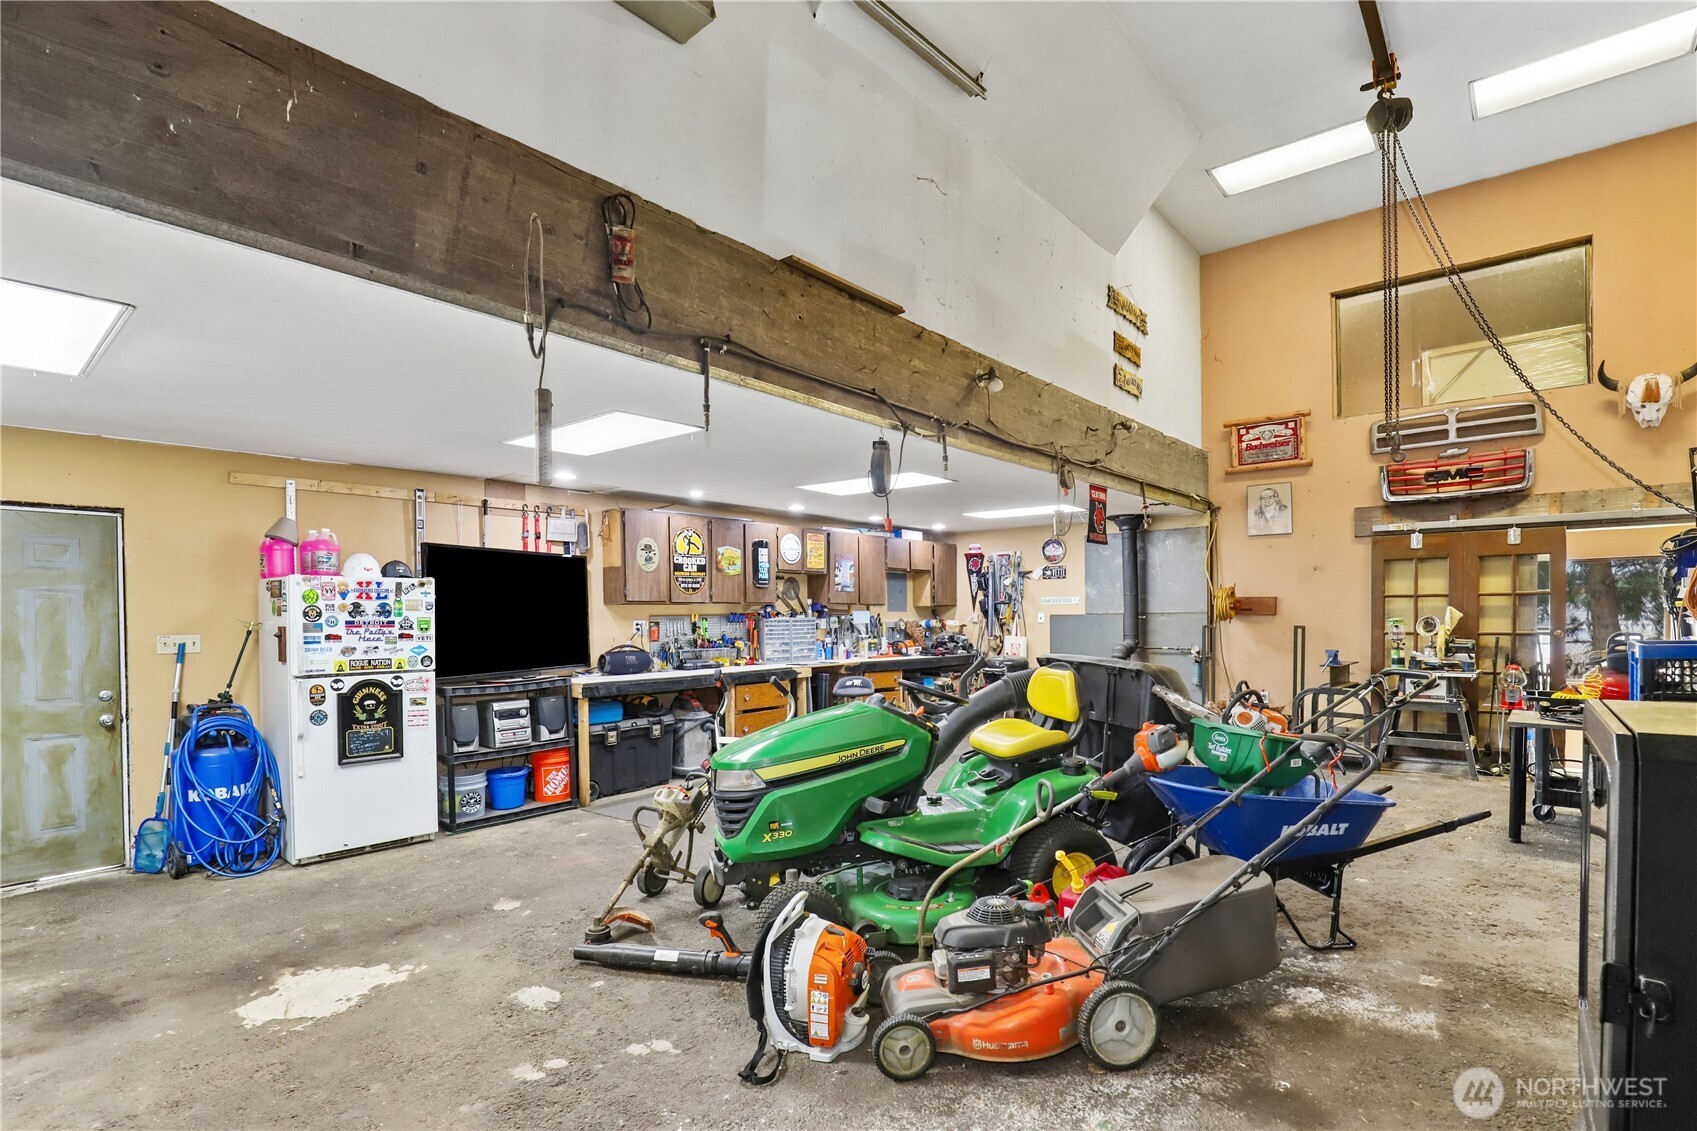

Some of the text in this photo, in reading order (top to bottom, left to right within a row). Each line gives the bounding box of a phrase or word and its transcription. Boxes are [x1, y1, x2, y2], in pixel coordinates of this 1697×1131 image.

[1245, 440, 1292, 451] Budweiser
[1424, 465, 1484, 482] GMC
[674, 557, 706, 565] CROOKED
[364, 629, 394, 637] Party's
[352, 687, 387, 704] GUINNESS
[836, 744, 885, 762] JOHN DEERE
[1215, 744, 1232, 754] Builder
[543, 765, 569, 796] HOME
[545, 769, 558, 783] THE
[555, 776, 569, 795] DEPOT
[461, 805, 480, 813] GUYS
[762, 830, 793, 843] X330
